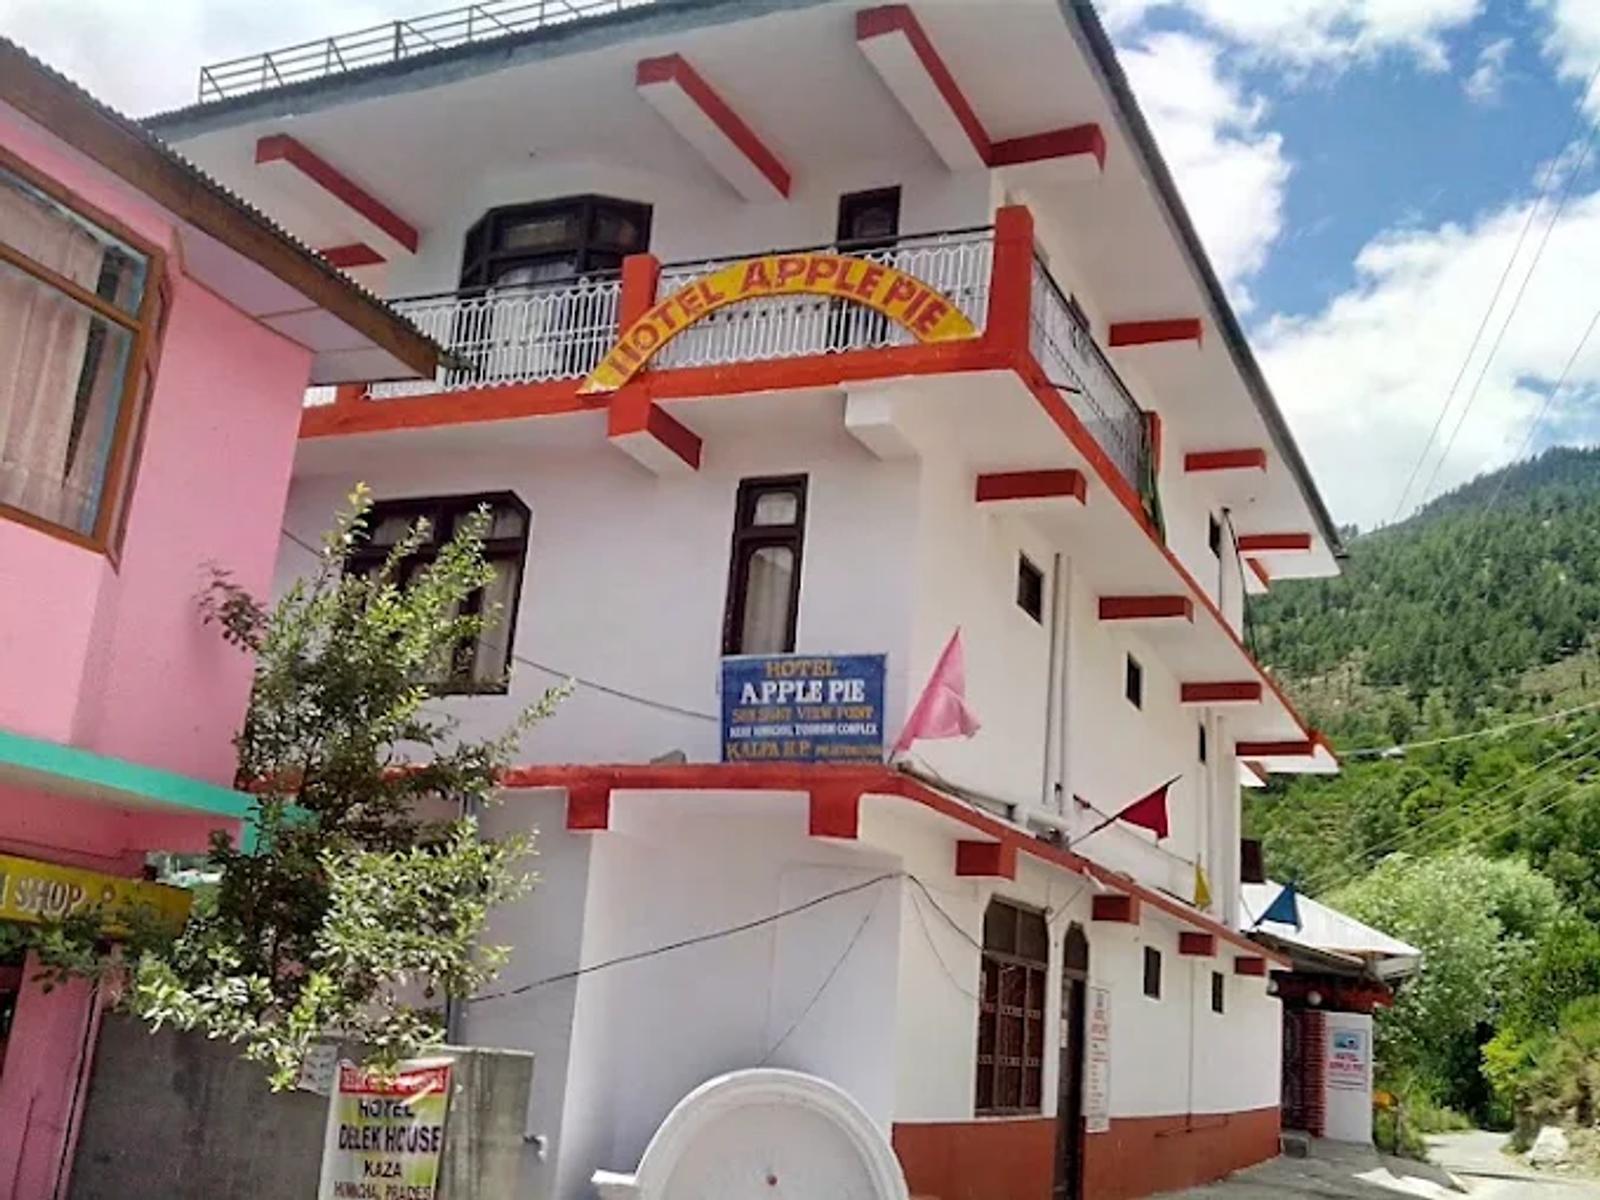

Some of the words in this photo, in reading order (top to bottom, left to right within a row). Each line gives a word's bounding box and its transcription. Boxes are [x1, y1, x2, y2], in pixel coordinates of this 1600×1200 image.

[608, 281, 724, 375] HOTEL
[741, 257, 884, 299] APPLE
[883, 279, 950, 332] PIE
[767, 660, 838, 677] HOTEL
[741, 680, 823, 704] APPLE
[828, 679, 865, 703] PIE
[837, 722, 878, 735] COMPLEX
[15, 877, 86, 921] SHOP
[357, 1099, 415, 1118] HOTEL
[385, 1125, 441, 1152] HOUSE
[364, 1159, 402, 1178] KAZA
